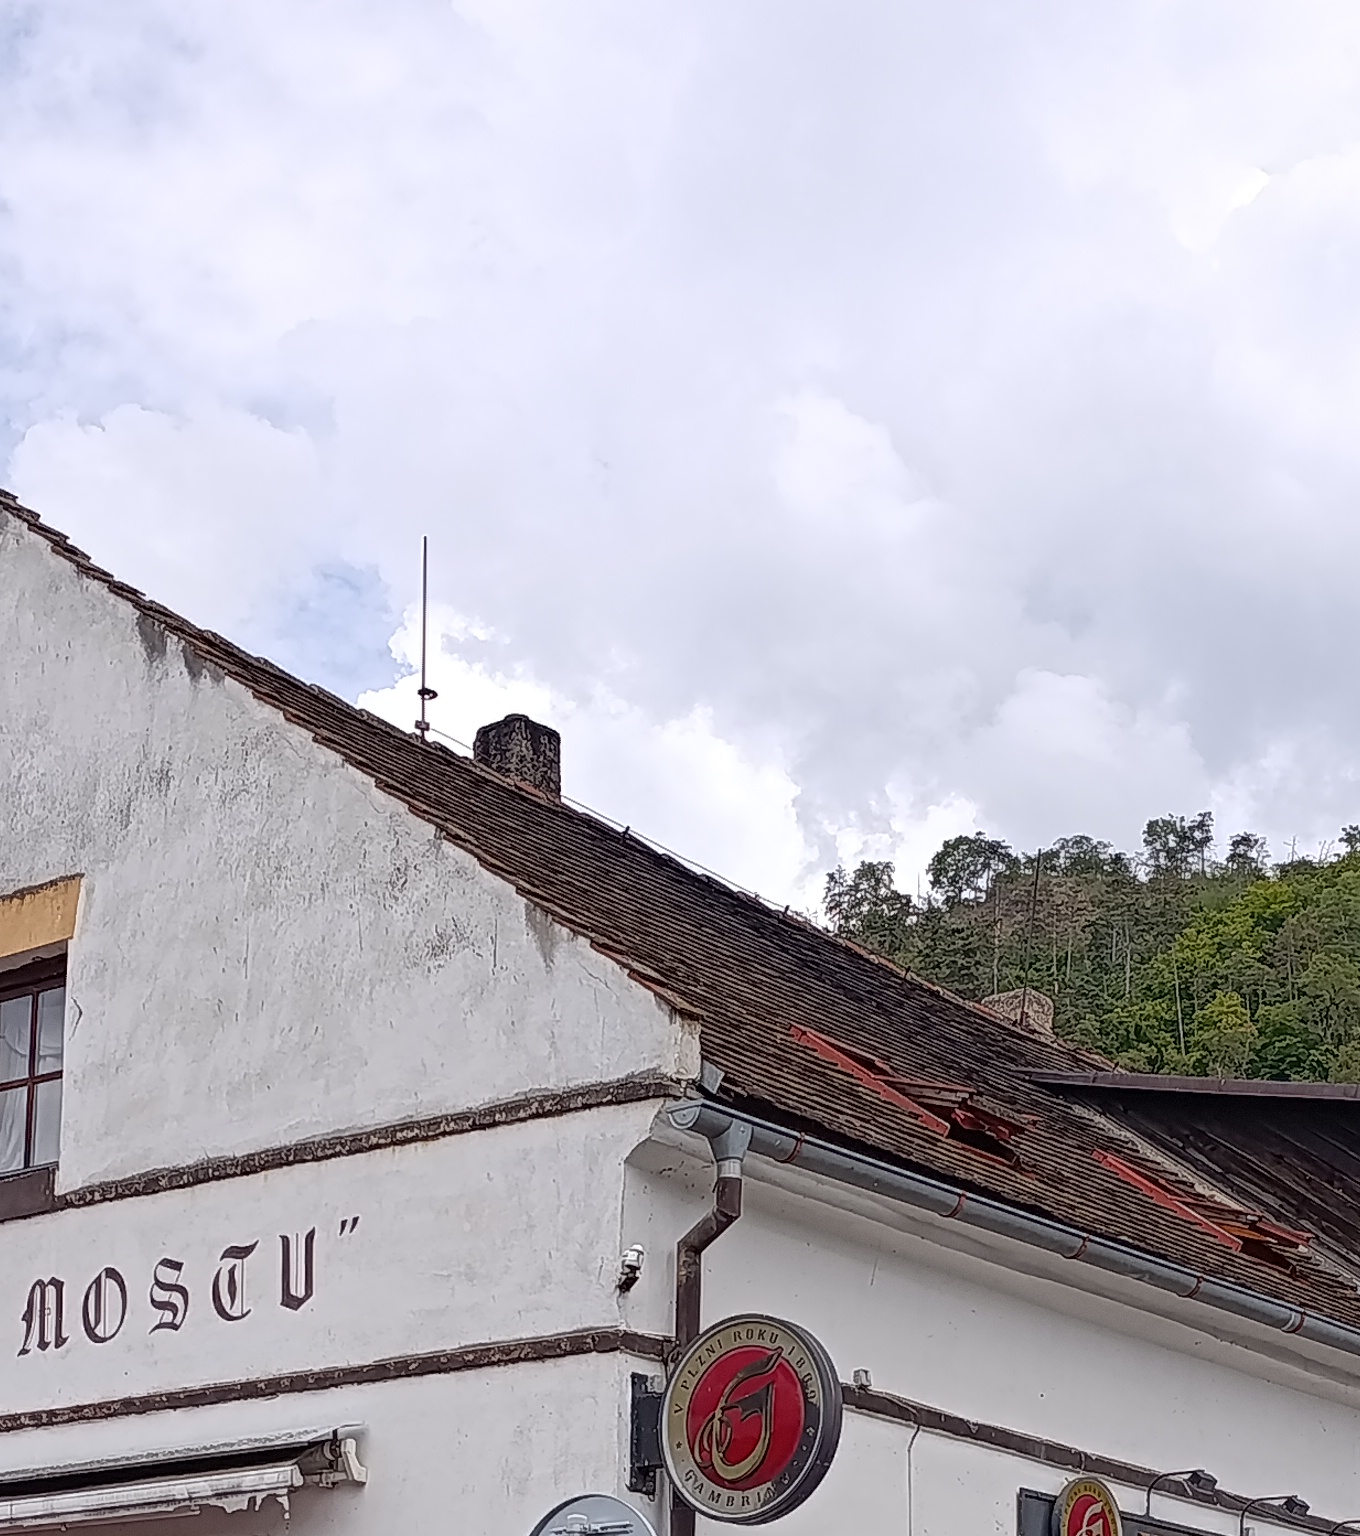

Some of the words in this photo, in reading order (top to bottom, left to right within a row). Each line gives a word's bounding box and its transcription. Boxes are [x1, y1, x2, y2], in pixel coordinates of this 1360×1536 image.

[673, 1403, 685, 1415] V
[680, 1338, 724, 1391] PLZNI
[732, 1327, 780, 1345] ROKU
